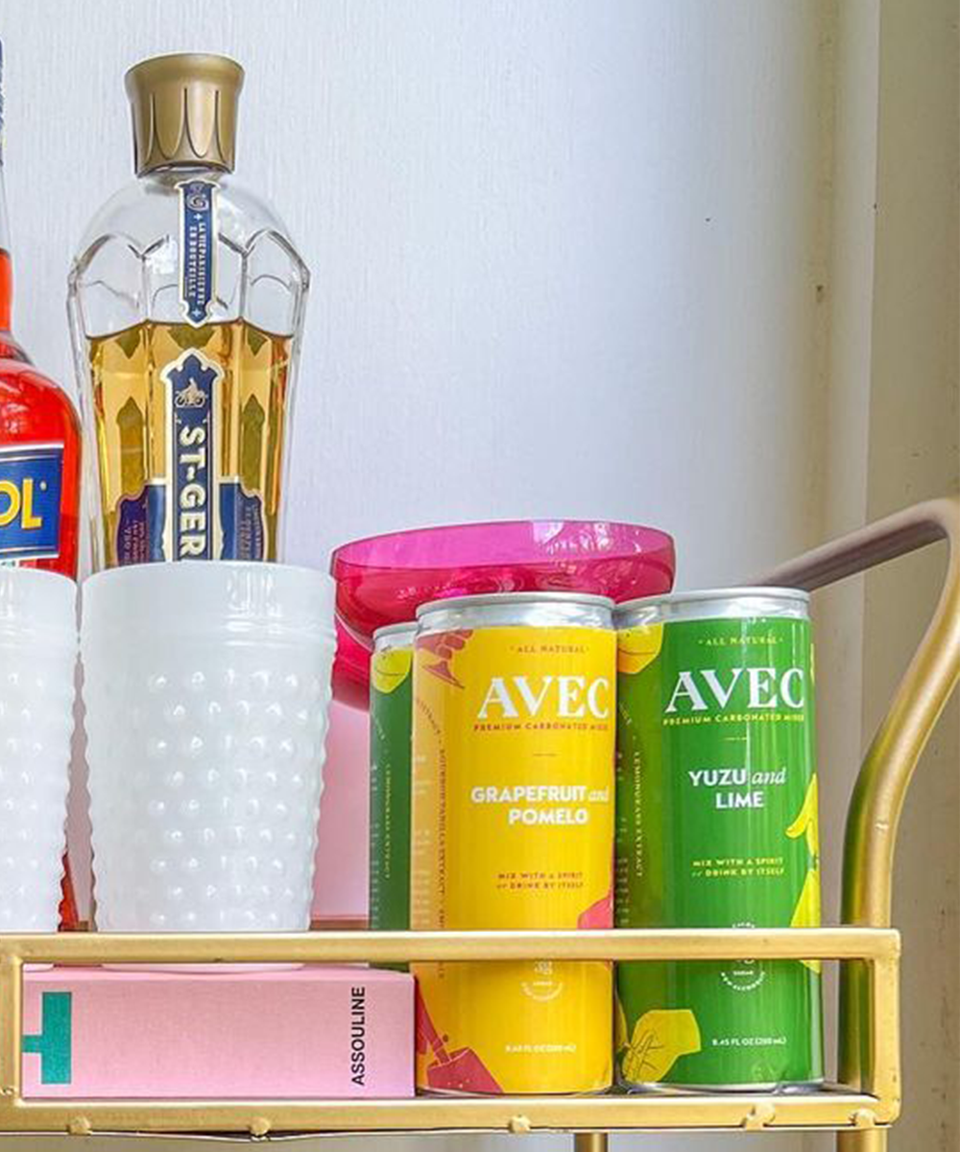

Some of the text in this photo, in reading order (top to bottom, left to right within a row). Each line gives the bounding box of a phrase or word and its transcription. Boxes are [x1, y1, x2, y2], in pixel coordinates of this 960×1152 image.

[705, 635, 778, 646] ALL NATURAL
[477, 675, 609, 719] AVEC
[664, 667, 804, 714] AVEC
[473, 723, 521, 731] PREMIUM
[663, 716, 711, 726] PREMIUM
[714, 713, 782, 723] CARBONATED
[688, 766, 786, 787] YUZU and
[470, 785, 586, 804] GRAPEFRUIT
[715, 791, 765, 809] LIME
[508, 809, 589, 826] POMELO
[350, 986, 365, 1087] ASSOULINE
